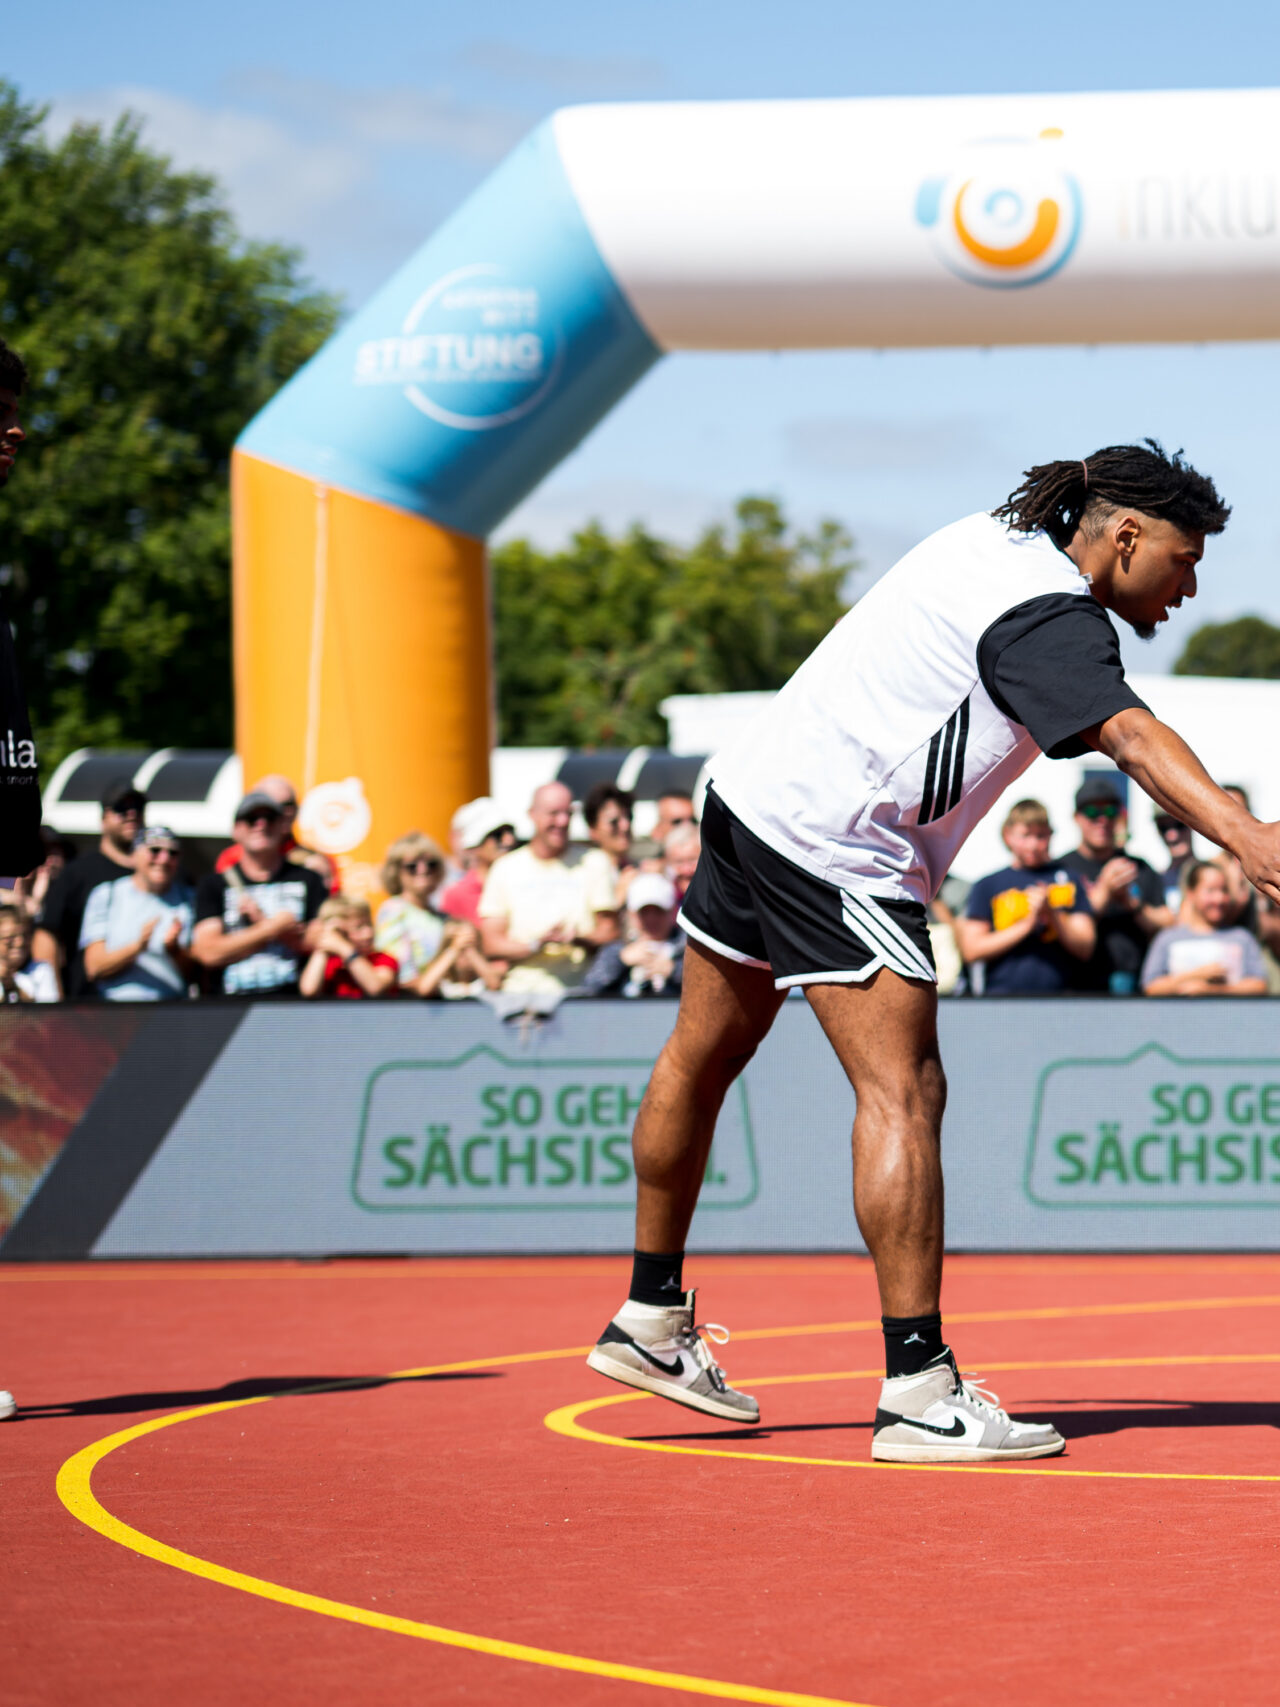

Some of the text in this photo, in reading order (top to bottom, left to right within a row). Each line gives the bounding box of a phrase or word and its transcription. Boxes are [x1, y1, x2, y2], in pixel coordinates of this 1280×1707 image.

[355, 332, 543, 373] STIFTUNG
[482, 1085, 648, 1127] SO GEH
[1152, 1083, 1212, 1125] SO
